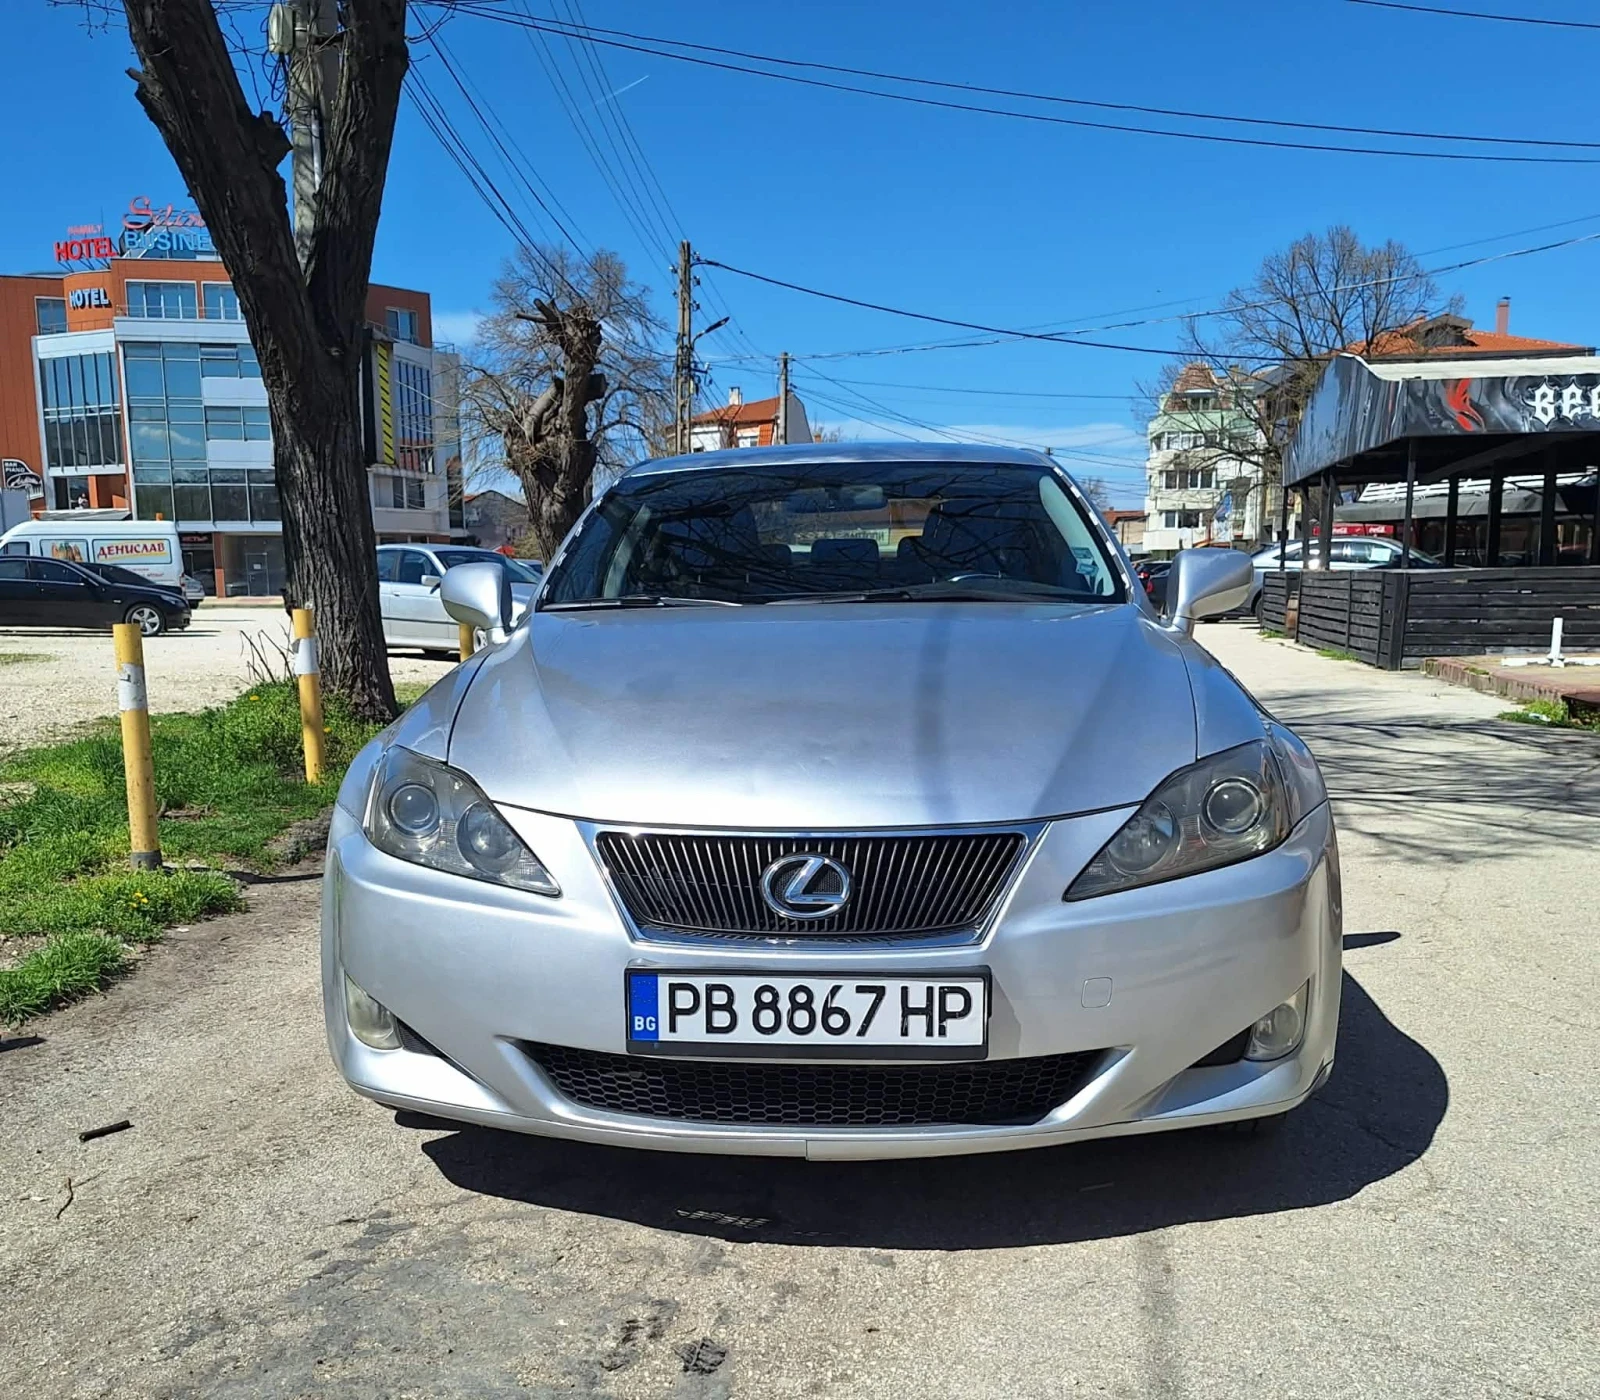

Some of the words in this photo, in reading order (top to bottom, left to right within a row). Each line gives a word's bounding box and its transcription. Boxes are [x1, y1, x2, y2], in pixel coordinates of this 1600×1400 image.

[54, 237, 118, 262] HOTEL
[124, 230, 211, 252] BUSINE
[69, 288, 110, 309] HOTEL
[98, 542, 166, 558] ДЕНИСЛАВ
[668, 982, 738, 1035] PB
[752, 984, 886, 1037] 8867
[900, 986, 972, 1037] HP
[634, 1015, 656, 1031] BG
